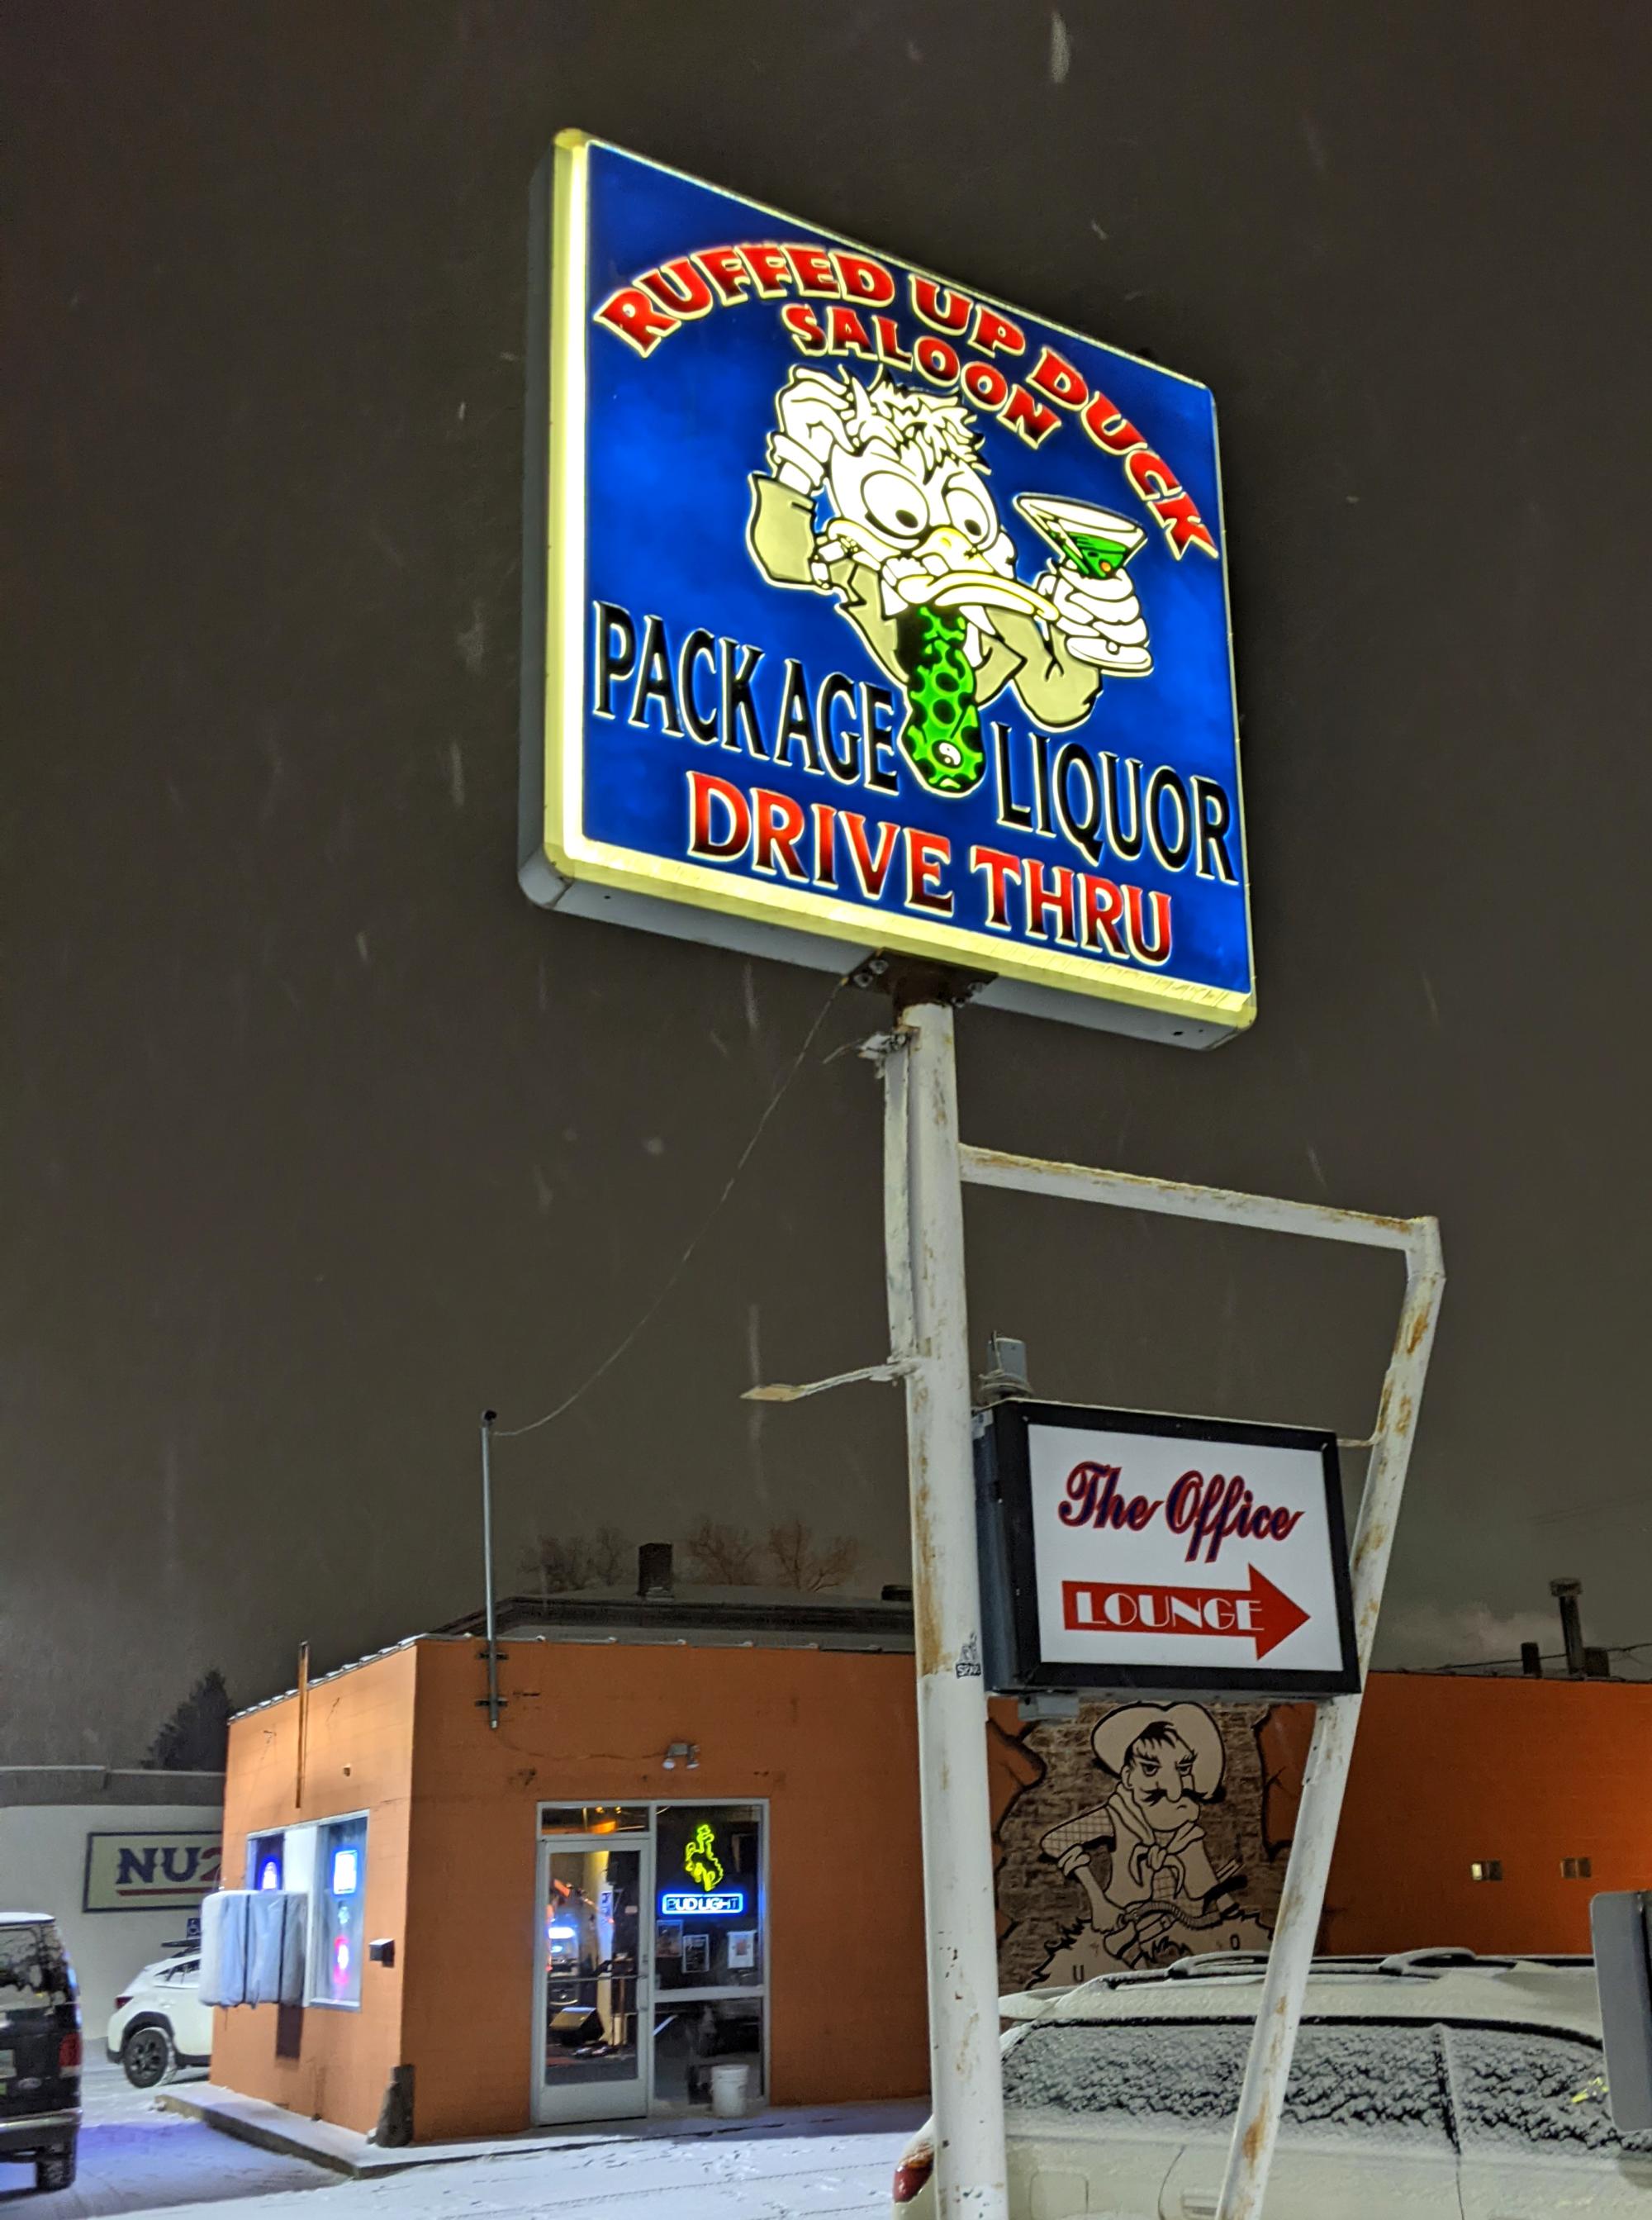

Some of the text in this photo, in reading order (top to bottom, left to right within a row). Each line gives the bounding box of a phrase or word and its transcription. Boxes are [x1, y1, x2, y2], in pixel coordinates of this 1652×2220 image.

[594, 240, 1218, 560] RUFFED UP DUCK
[782, 303, 1062, 449] SALOON
[593, 601, 1238, 885] PACKAGE LIQUOR
[686, 771, 1172, 966] DRIVE THRU
[1057, 1461, 1305, 1563] The Office
[1076, 1591, 1265, 1631] LOUNGE
[667, 1897, 738, 1910] BUD LIGHT
